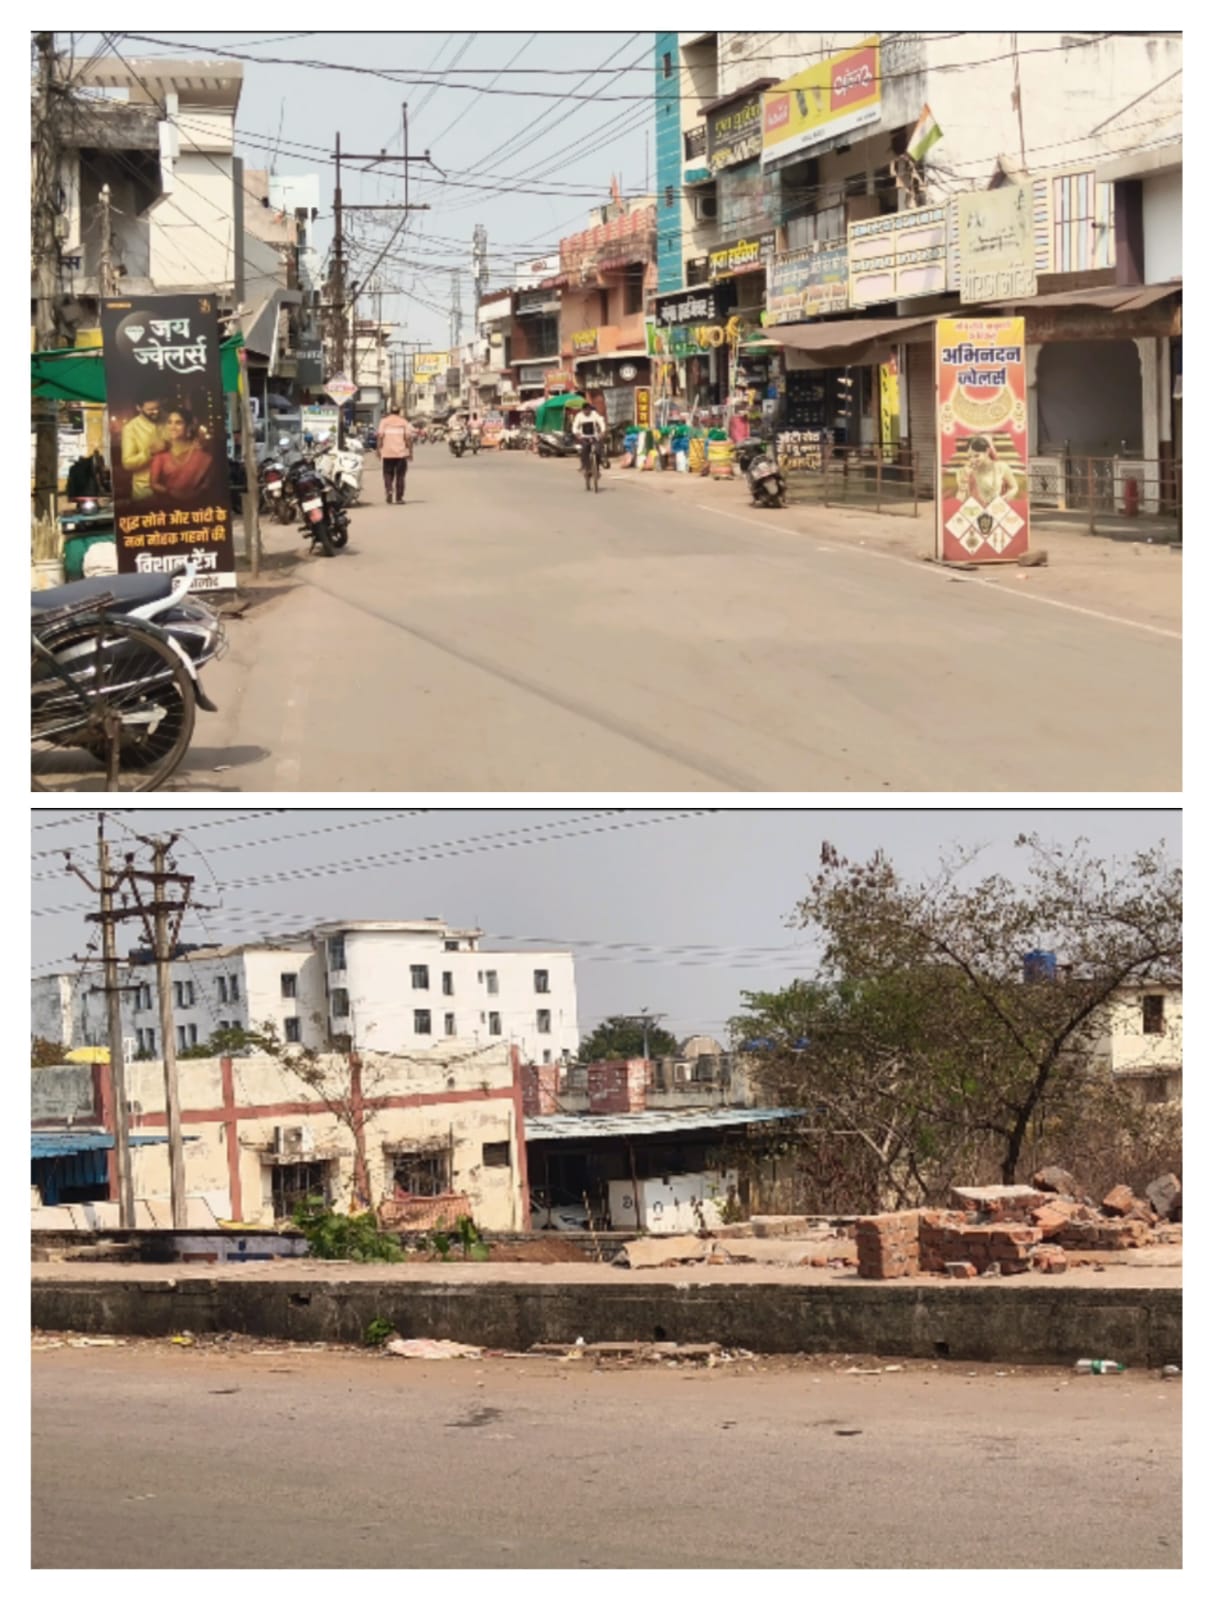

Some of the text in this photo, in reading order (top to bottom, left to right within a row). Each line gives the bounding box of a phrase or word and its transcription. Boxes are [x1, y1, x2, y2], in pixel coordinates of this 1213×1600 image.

[149, 318, 190, 342] जय
[132, 335, 207, 373] ज्वेलर्स
[943, 342, 1021, 363] अभिनंदन
[119, 516, 140, 534] शुद्ध
[142, 511, 166, 528] सोने
[169, 509, 190, 525] और
[215, 506, 227, 521] के
[123, 534, 145, 547] मन
[211, 525, 226, 541] की
[192, 548, 218, 570] रेंज
